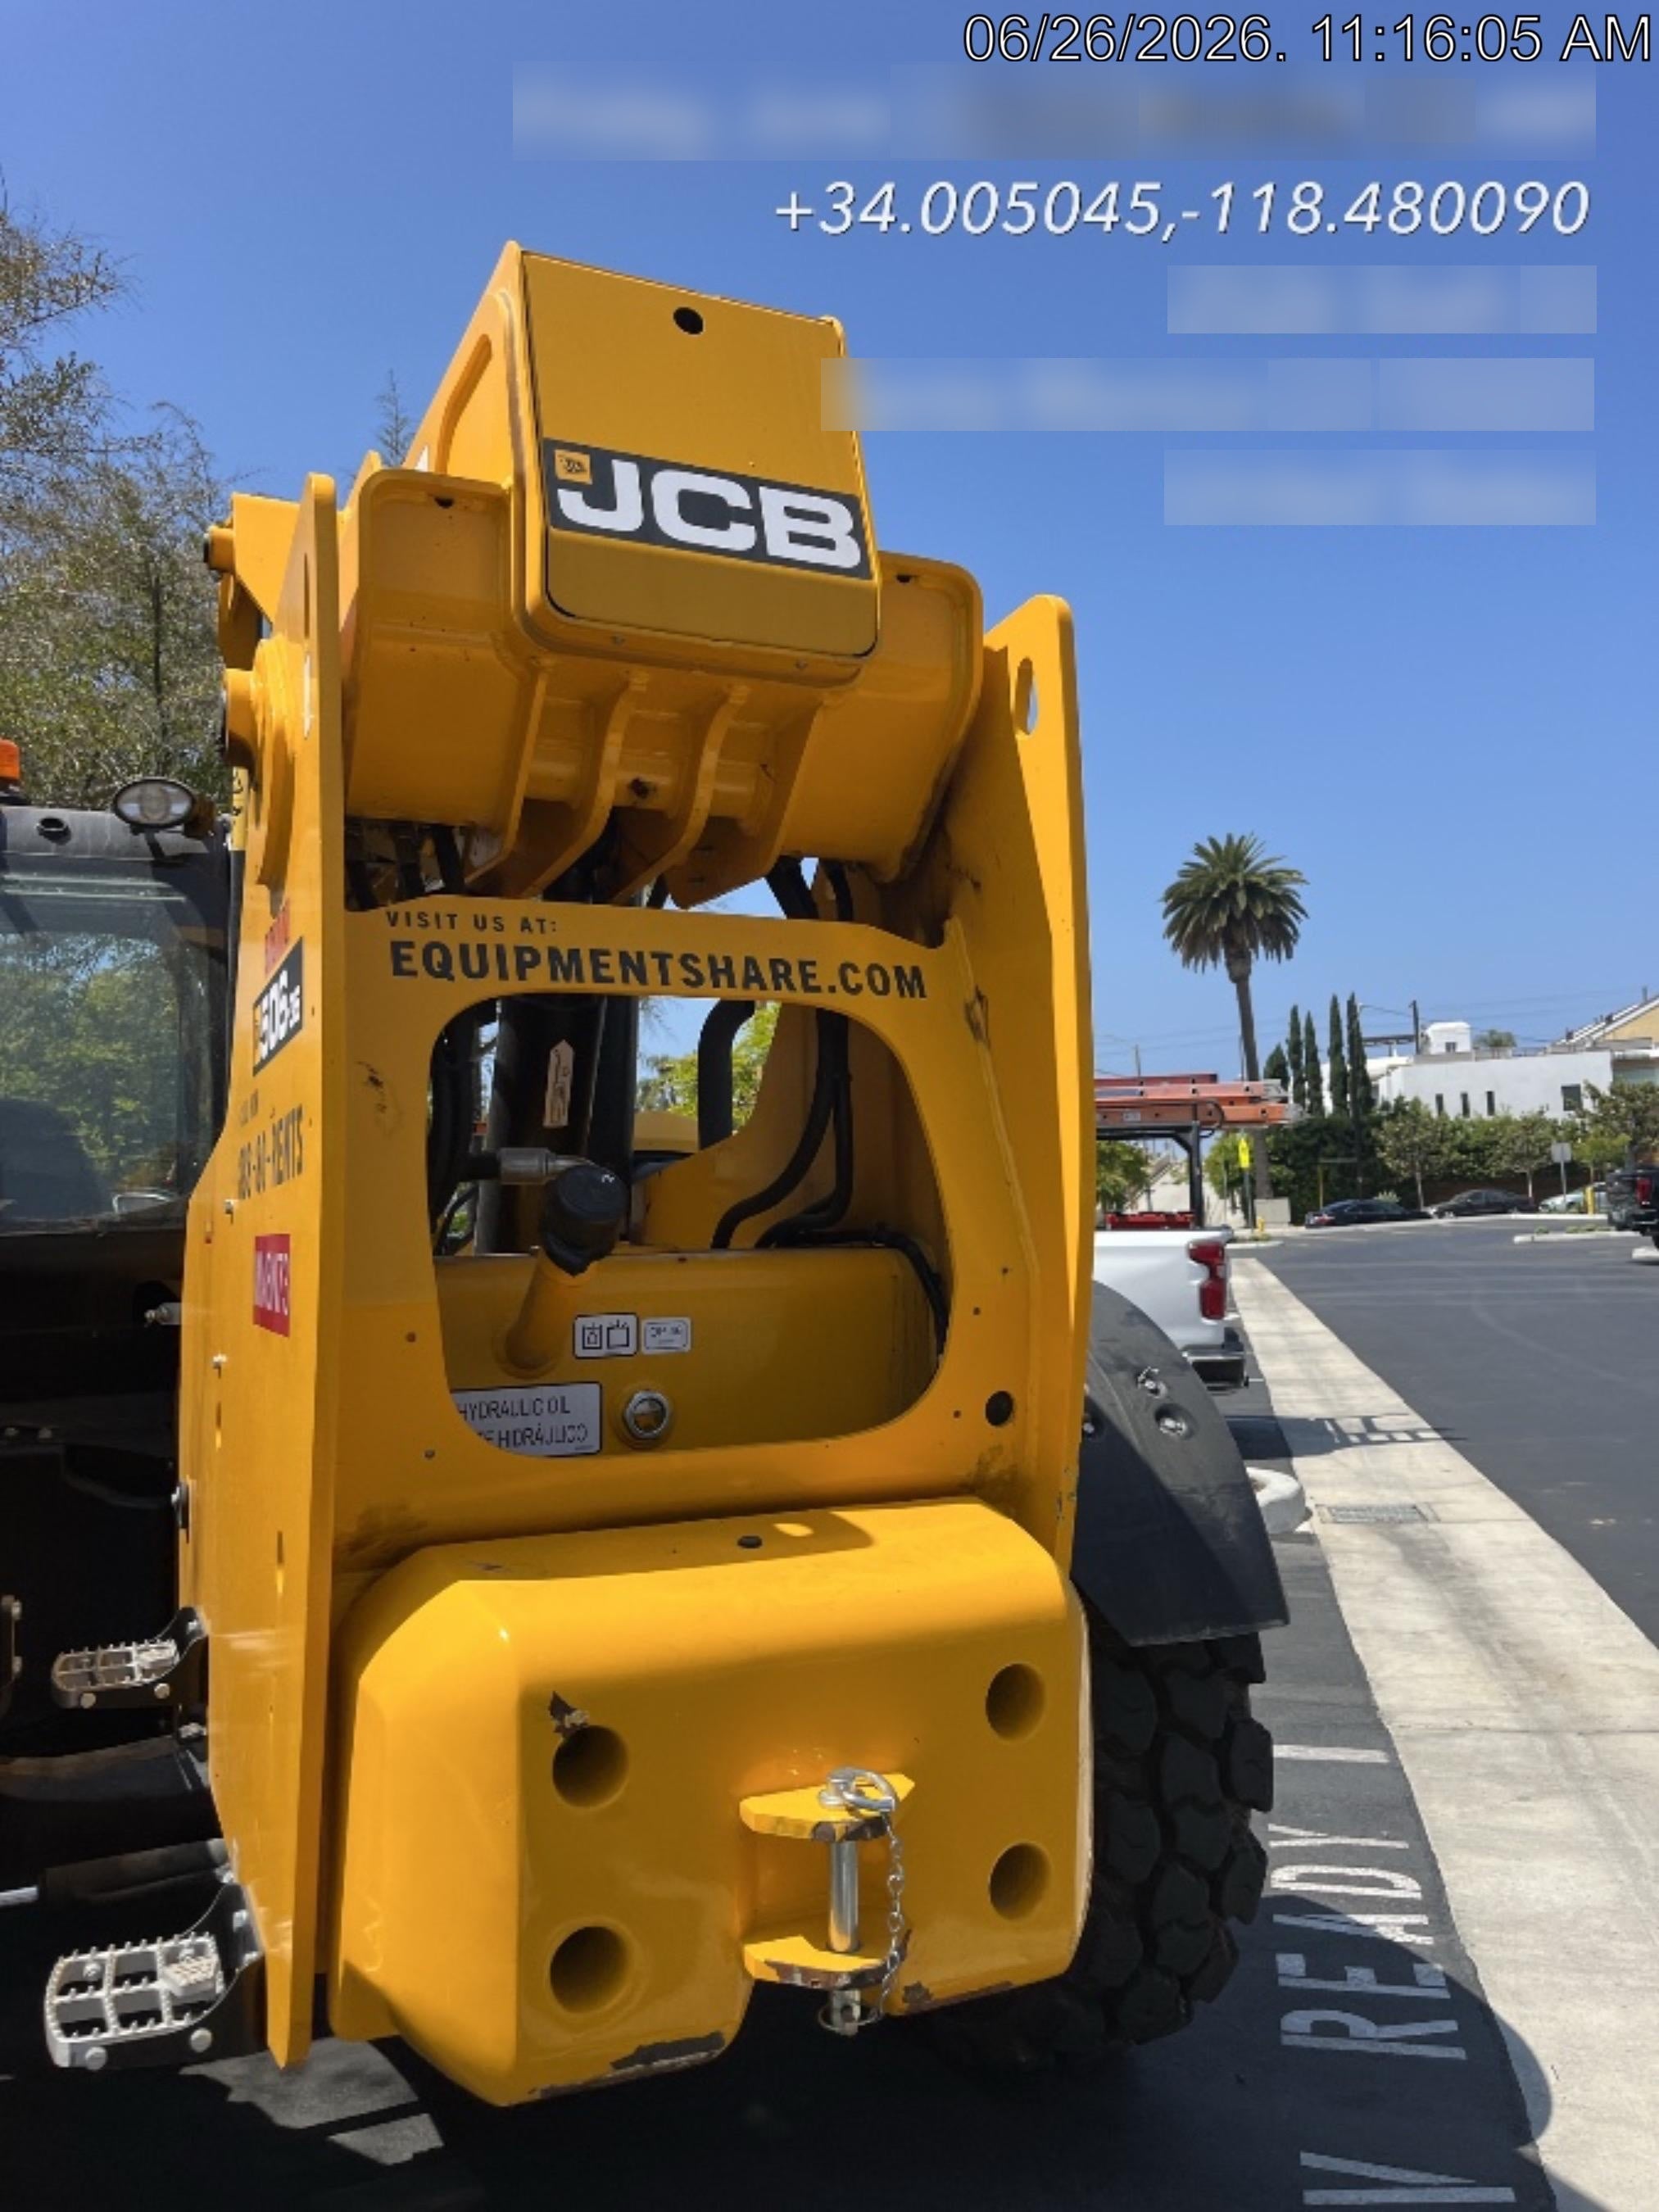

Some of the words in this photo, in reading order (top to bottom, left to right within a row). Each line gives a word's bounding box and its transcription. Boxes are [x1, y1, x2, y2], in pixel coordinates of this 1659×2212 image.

[557, 459, 862, 569] JCB
[386, 910, 459, 931] VISIT
[474, 913, 505, 933] US
[519, 916, 557, 935] AT:
[389, 939, 927, 999] EQUIPMENTSHARE.COM
[1267, 1822, 1466, 2060] READY
